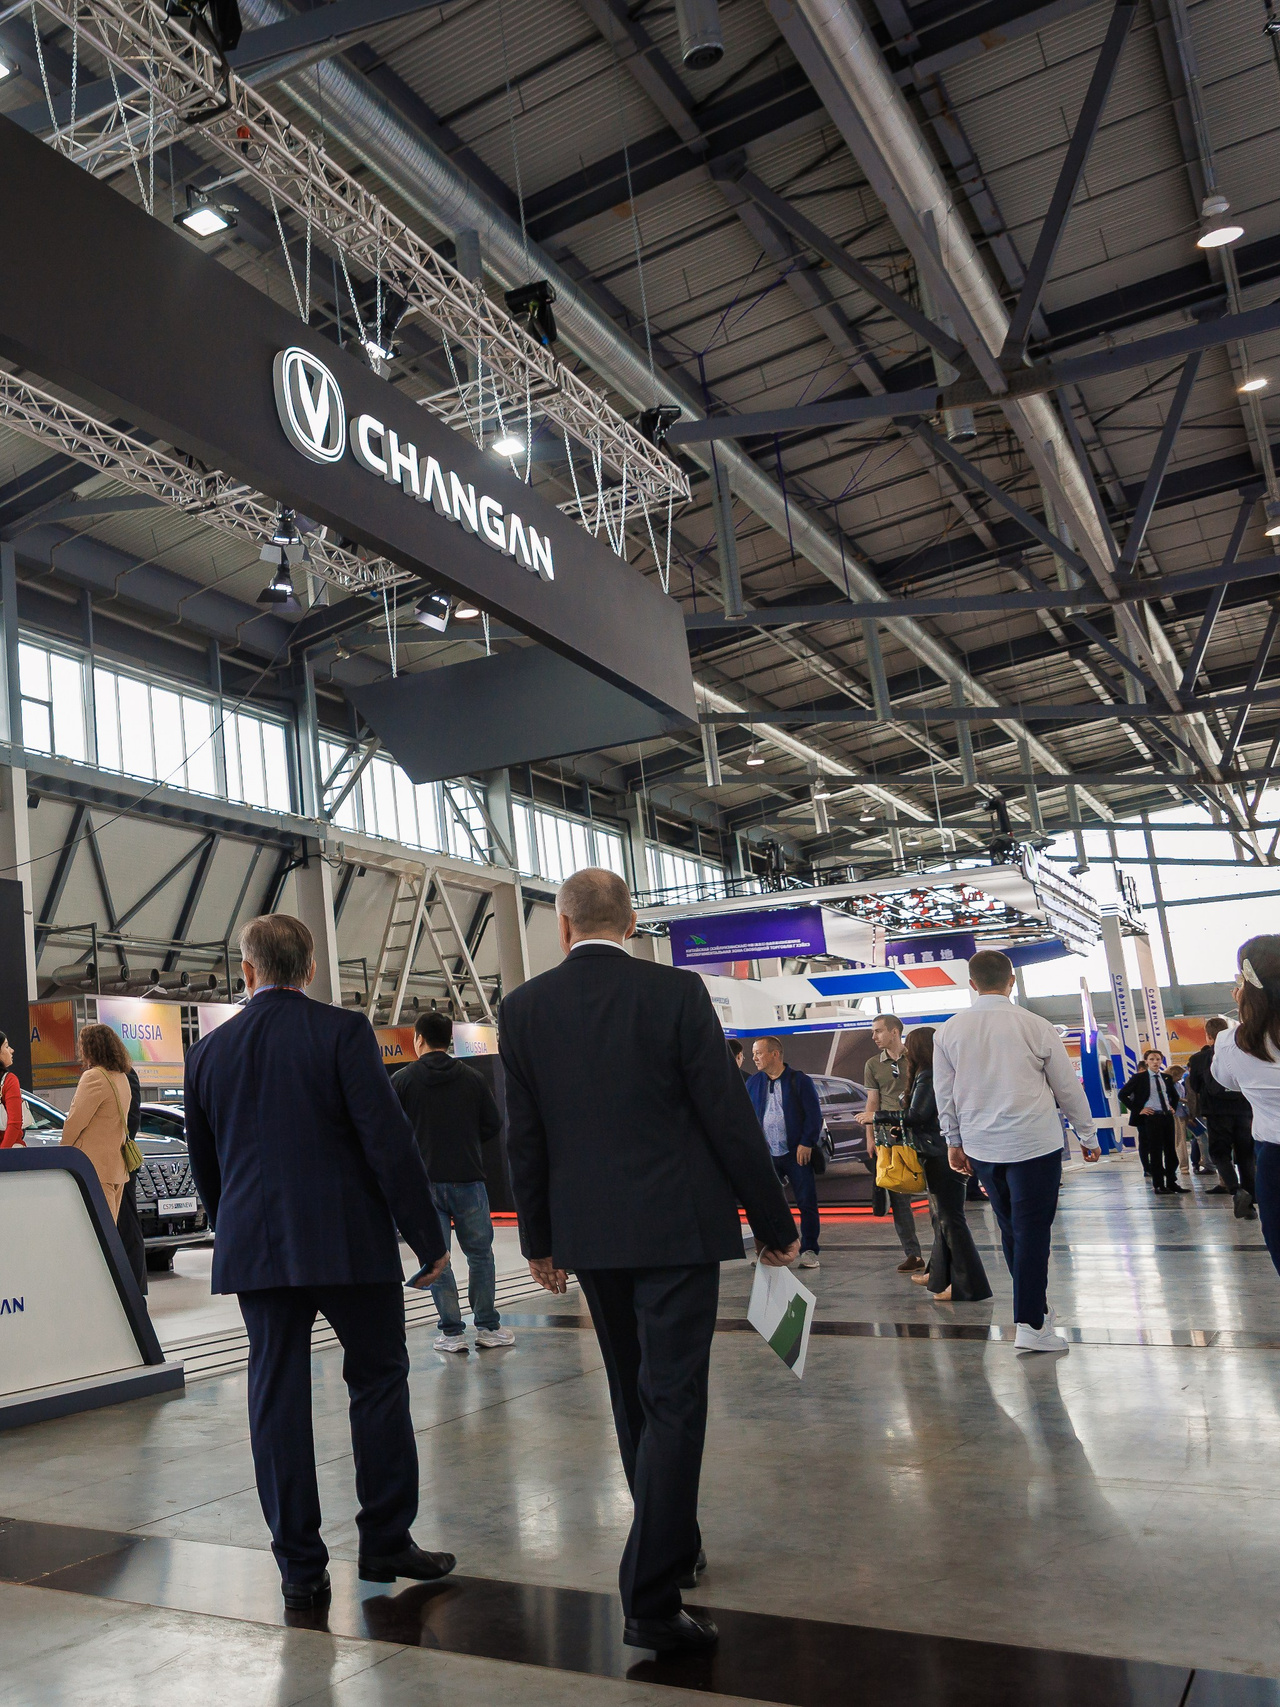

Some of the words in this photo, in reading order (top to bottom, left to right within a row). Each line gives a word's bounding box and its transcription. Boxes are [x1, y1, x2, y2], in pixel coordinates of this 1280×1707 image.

[350, 413, 556, 582] CHANGAN
[121, 1023, 162, 1040] RUSSIA
[381, 1044, 403, 1057] INA
[465, 1041, 487, 1053] RUSSIA
